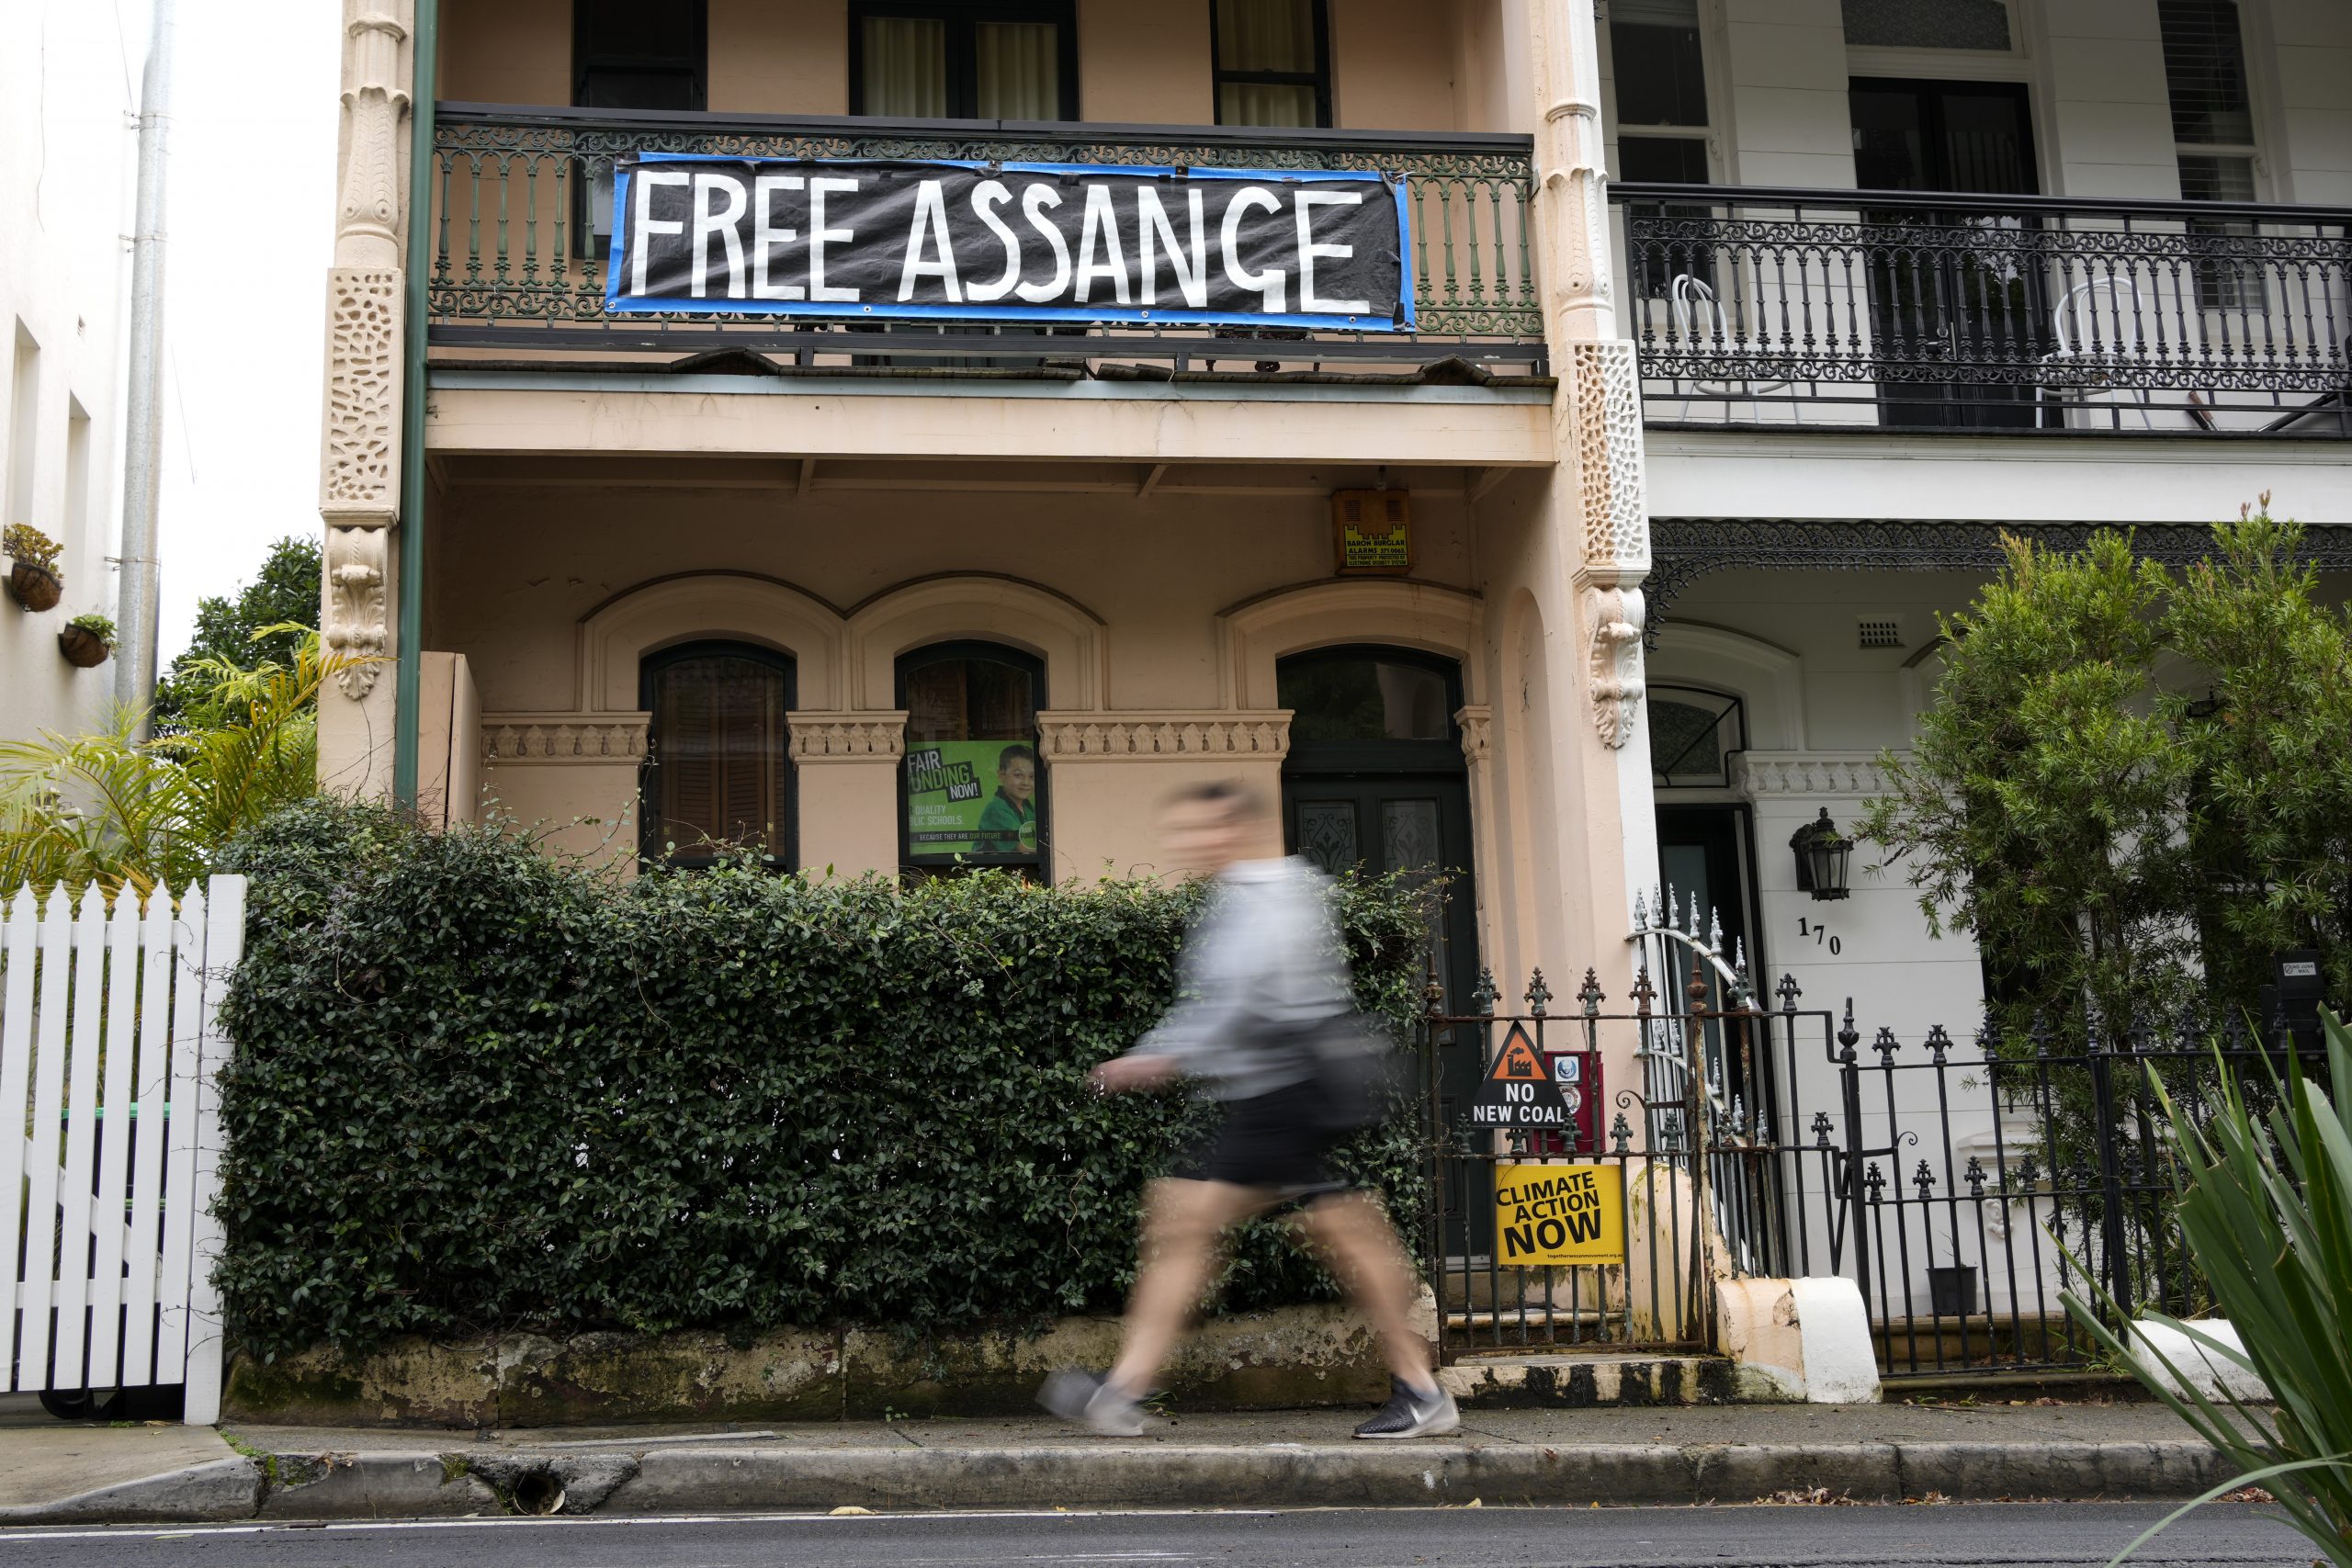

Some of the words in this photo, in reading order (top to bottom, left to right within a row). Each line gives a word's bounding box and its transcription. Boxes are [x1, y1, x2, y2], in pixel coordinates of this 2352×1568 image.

[631, 170, 860, 301] FREE
[897, 179, 1370, 314] ASSANGE
[908, 751, 942, 773] FAIR
[908, 764, 971, 792] UNDING
[949, 782, 978, 799] NOW!
[915, 805, 946, 816] QUALITY
[919, 833, 943, 841] BECAUSE
[944, 832, 956, 840] THEY
[1797, 917, 1841, 955] 170
[1506, 1083, 1534, 1102] NO
[1473, 1105, 1512, 1122] NEW
[1519, 1105, 1565, 1122] COAL
[1496, 1171, 1595, 1206] CLIMATE
[1514, 1189, 1600, 1224] ACTION
[1503, 1208, 1600, 1258] NOW
